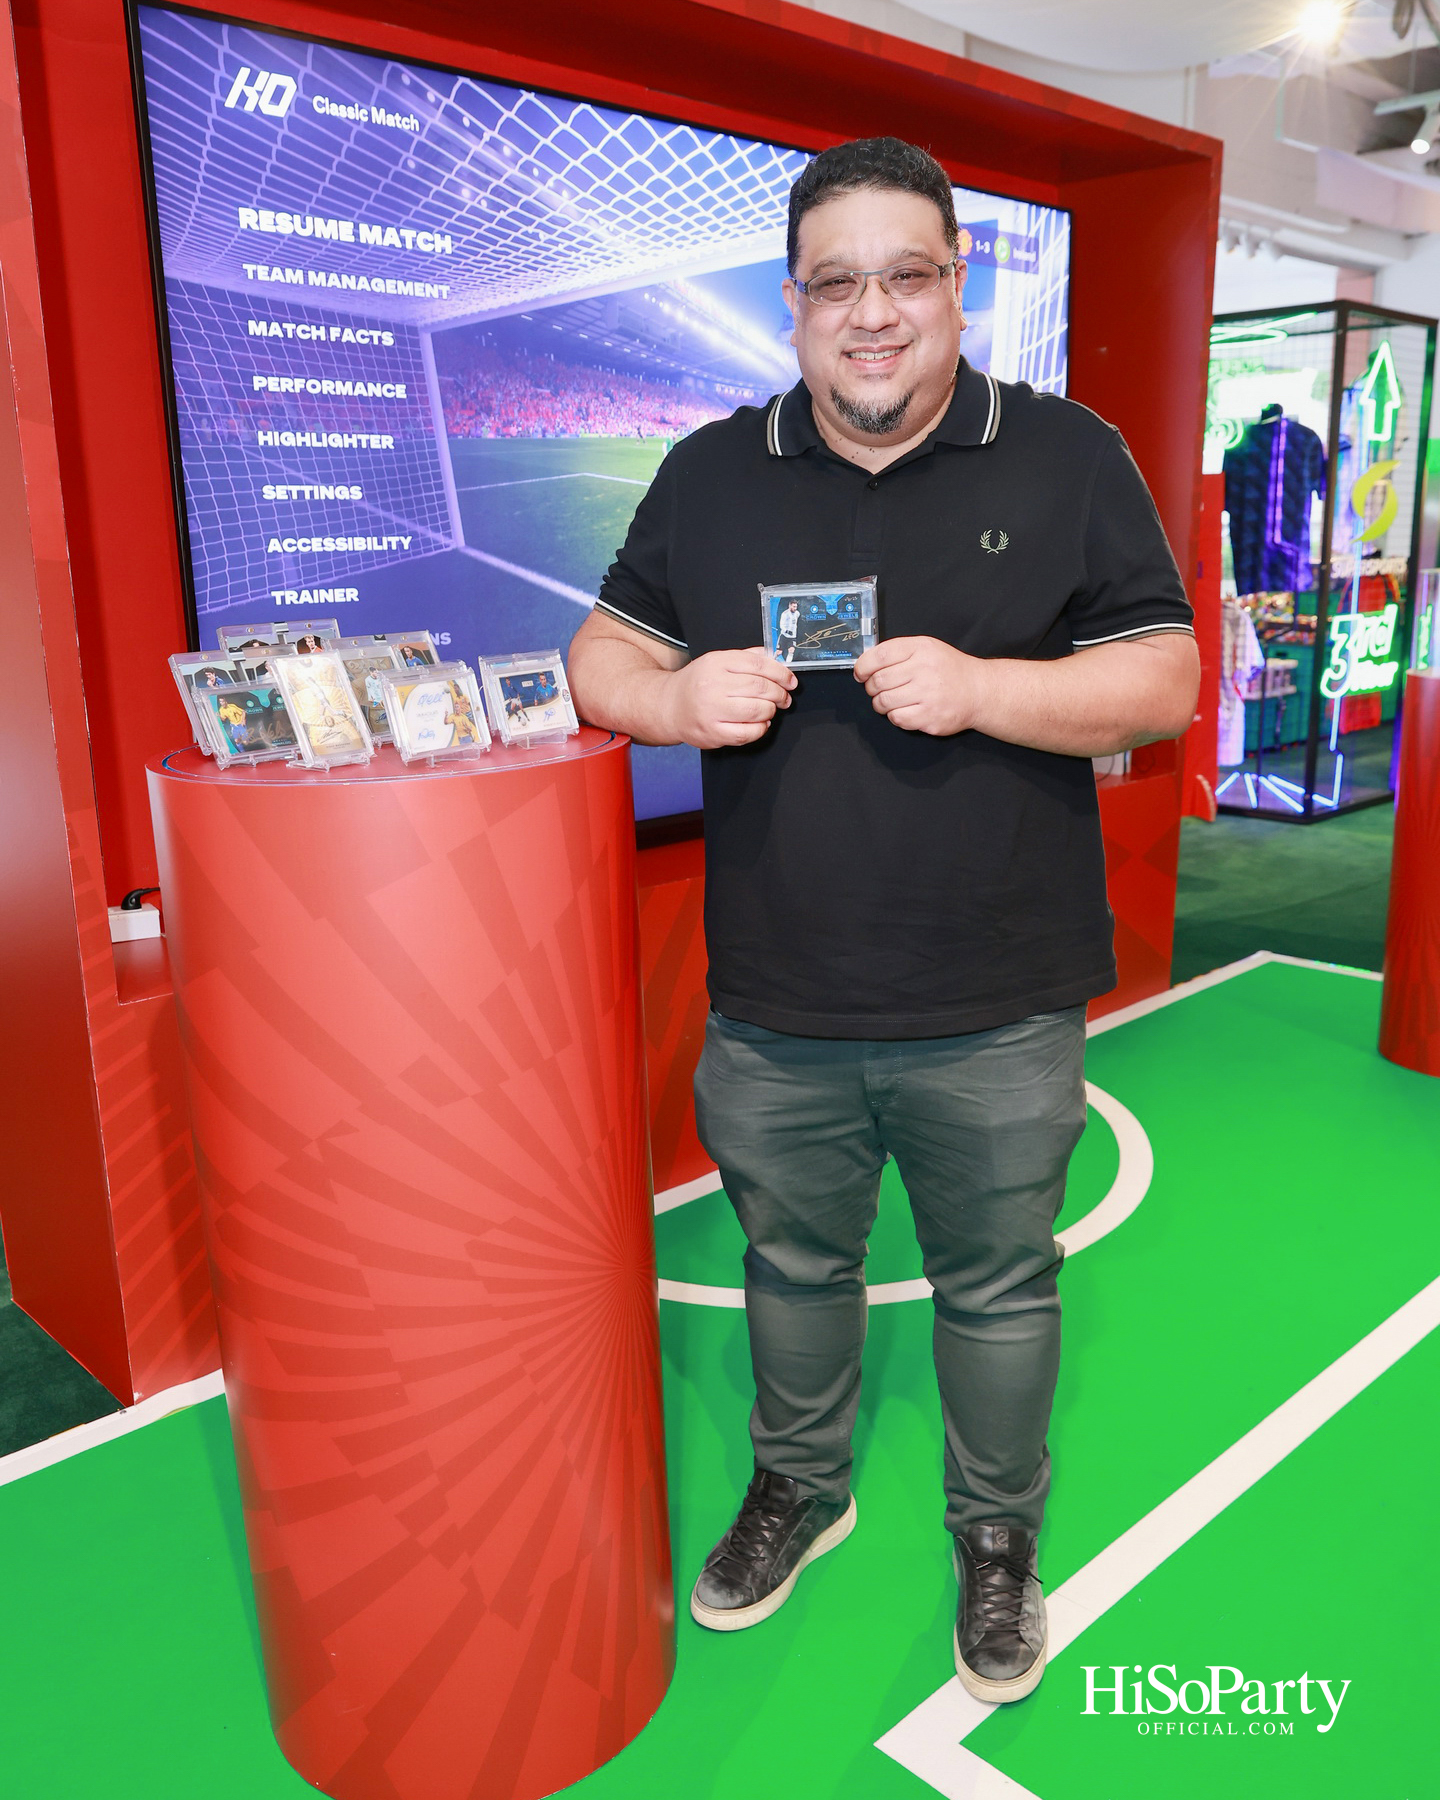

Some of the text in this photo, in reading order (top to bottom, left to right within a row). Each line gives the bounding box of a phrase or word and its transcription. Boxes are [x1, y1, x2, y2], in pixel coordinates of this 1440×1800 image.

[312, 95, 420, 132] Classic Match
[238, 206, 453, 254] RESUME MATCH
[242, 263, 451, 300] TEAM MANAGEMENT
[247, 320, 395, 347] MATCH FACTS
[252, 375, 408, 399] PERFORMANCE
[257, 430, 395, 450] HIGHLIGHTER
[262, 484, 364, 501] SETTINGS
[267, 535, 413, 554] ACCESSIBILITY
[270, 587, 360, 606] TRAINER
